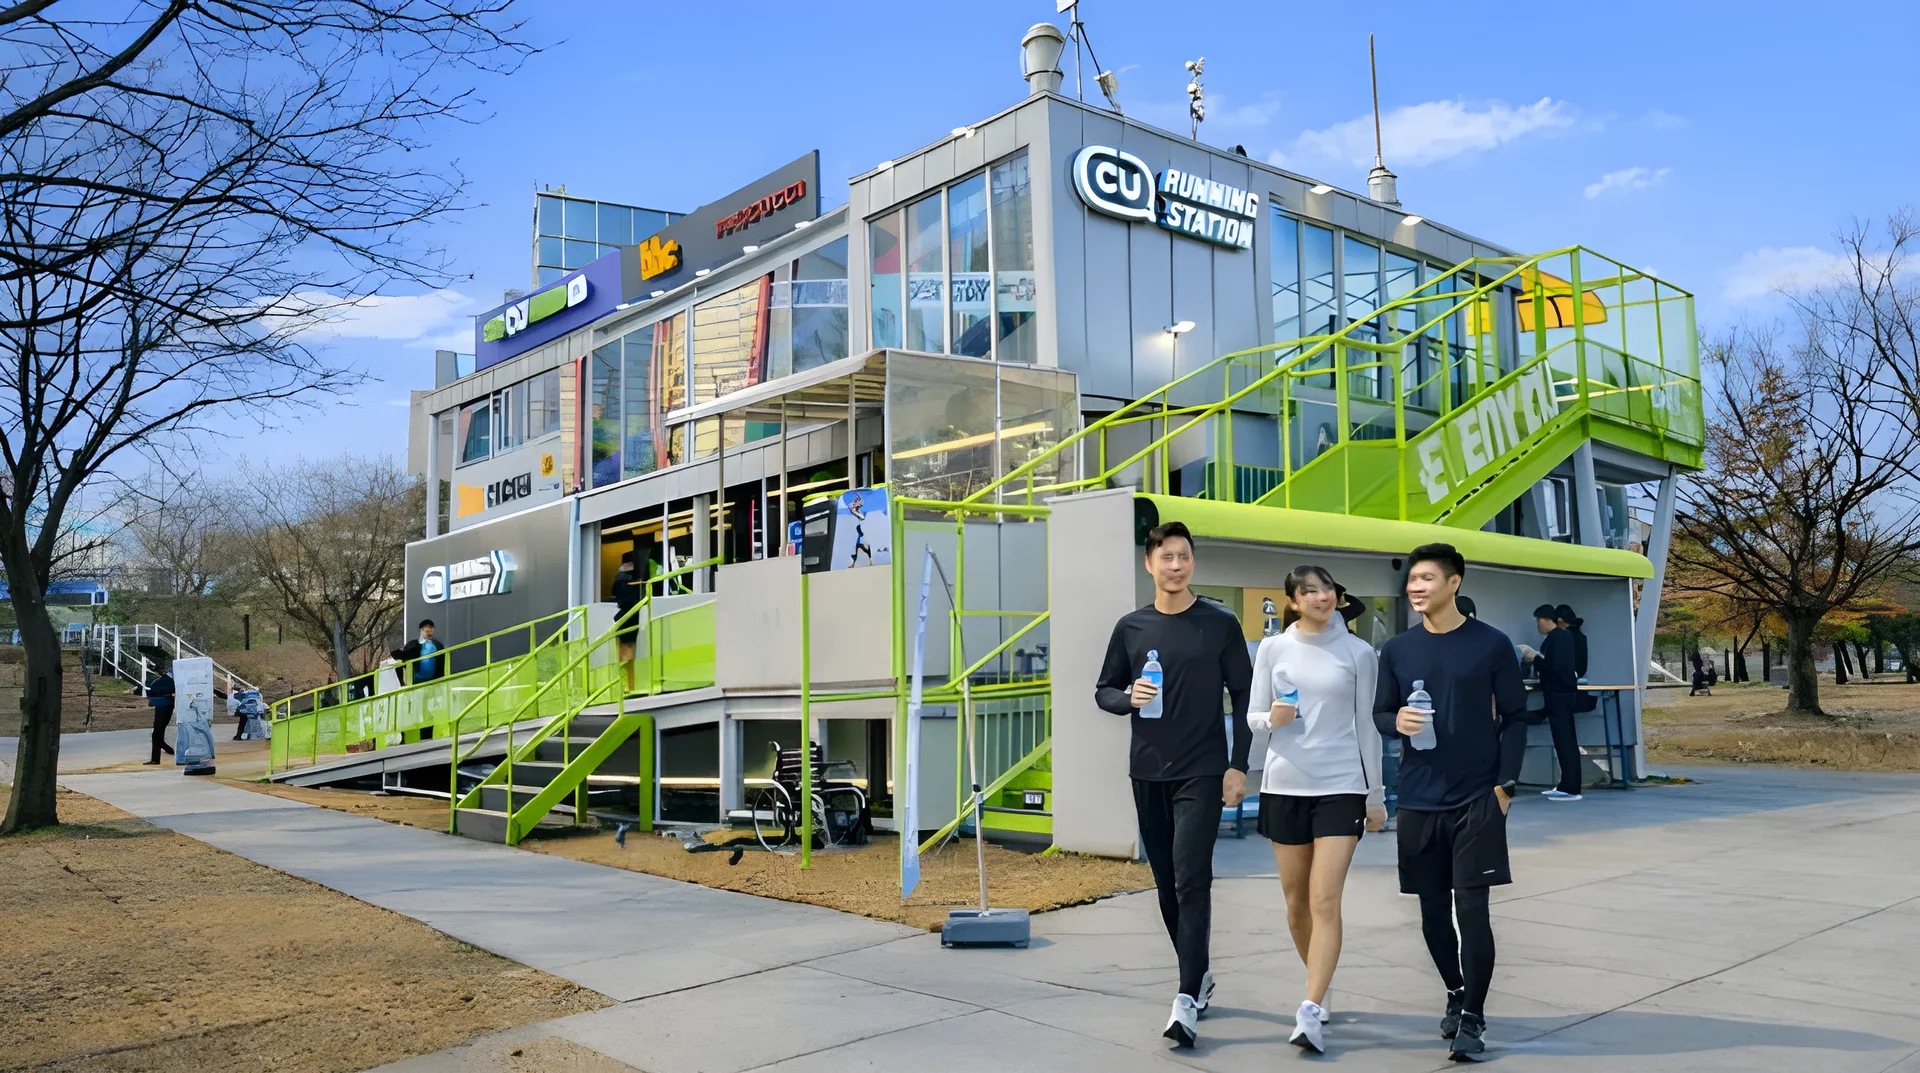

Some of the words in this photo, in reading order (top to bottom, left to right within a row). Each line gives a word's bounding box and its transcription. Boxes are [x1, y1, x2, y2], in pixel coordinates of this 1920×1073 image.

[1096, 161, 1141, 200] CU
[1164, 169, 1259, 218] RUNNING
[1166, 201, 1253, 249] STATION
